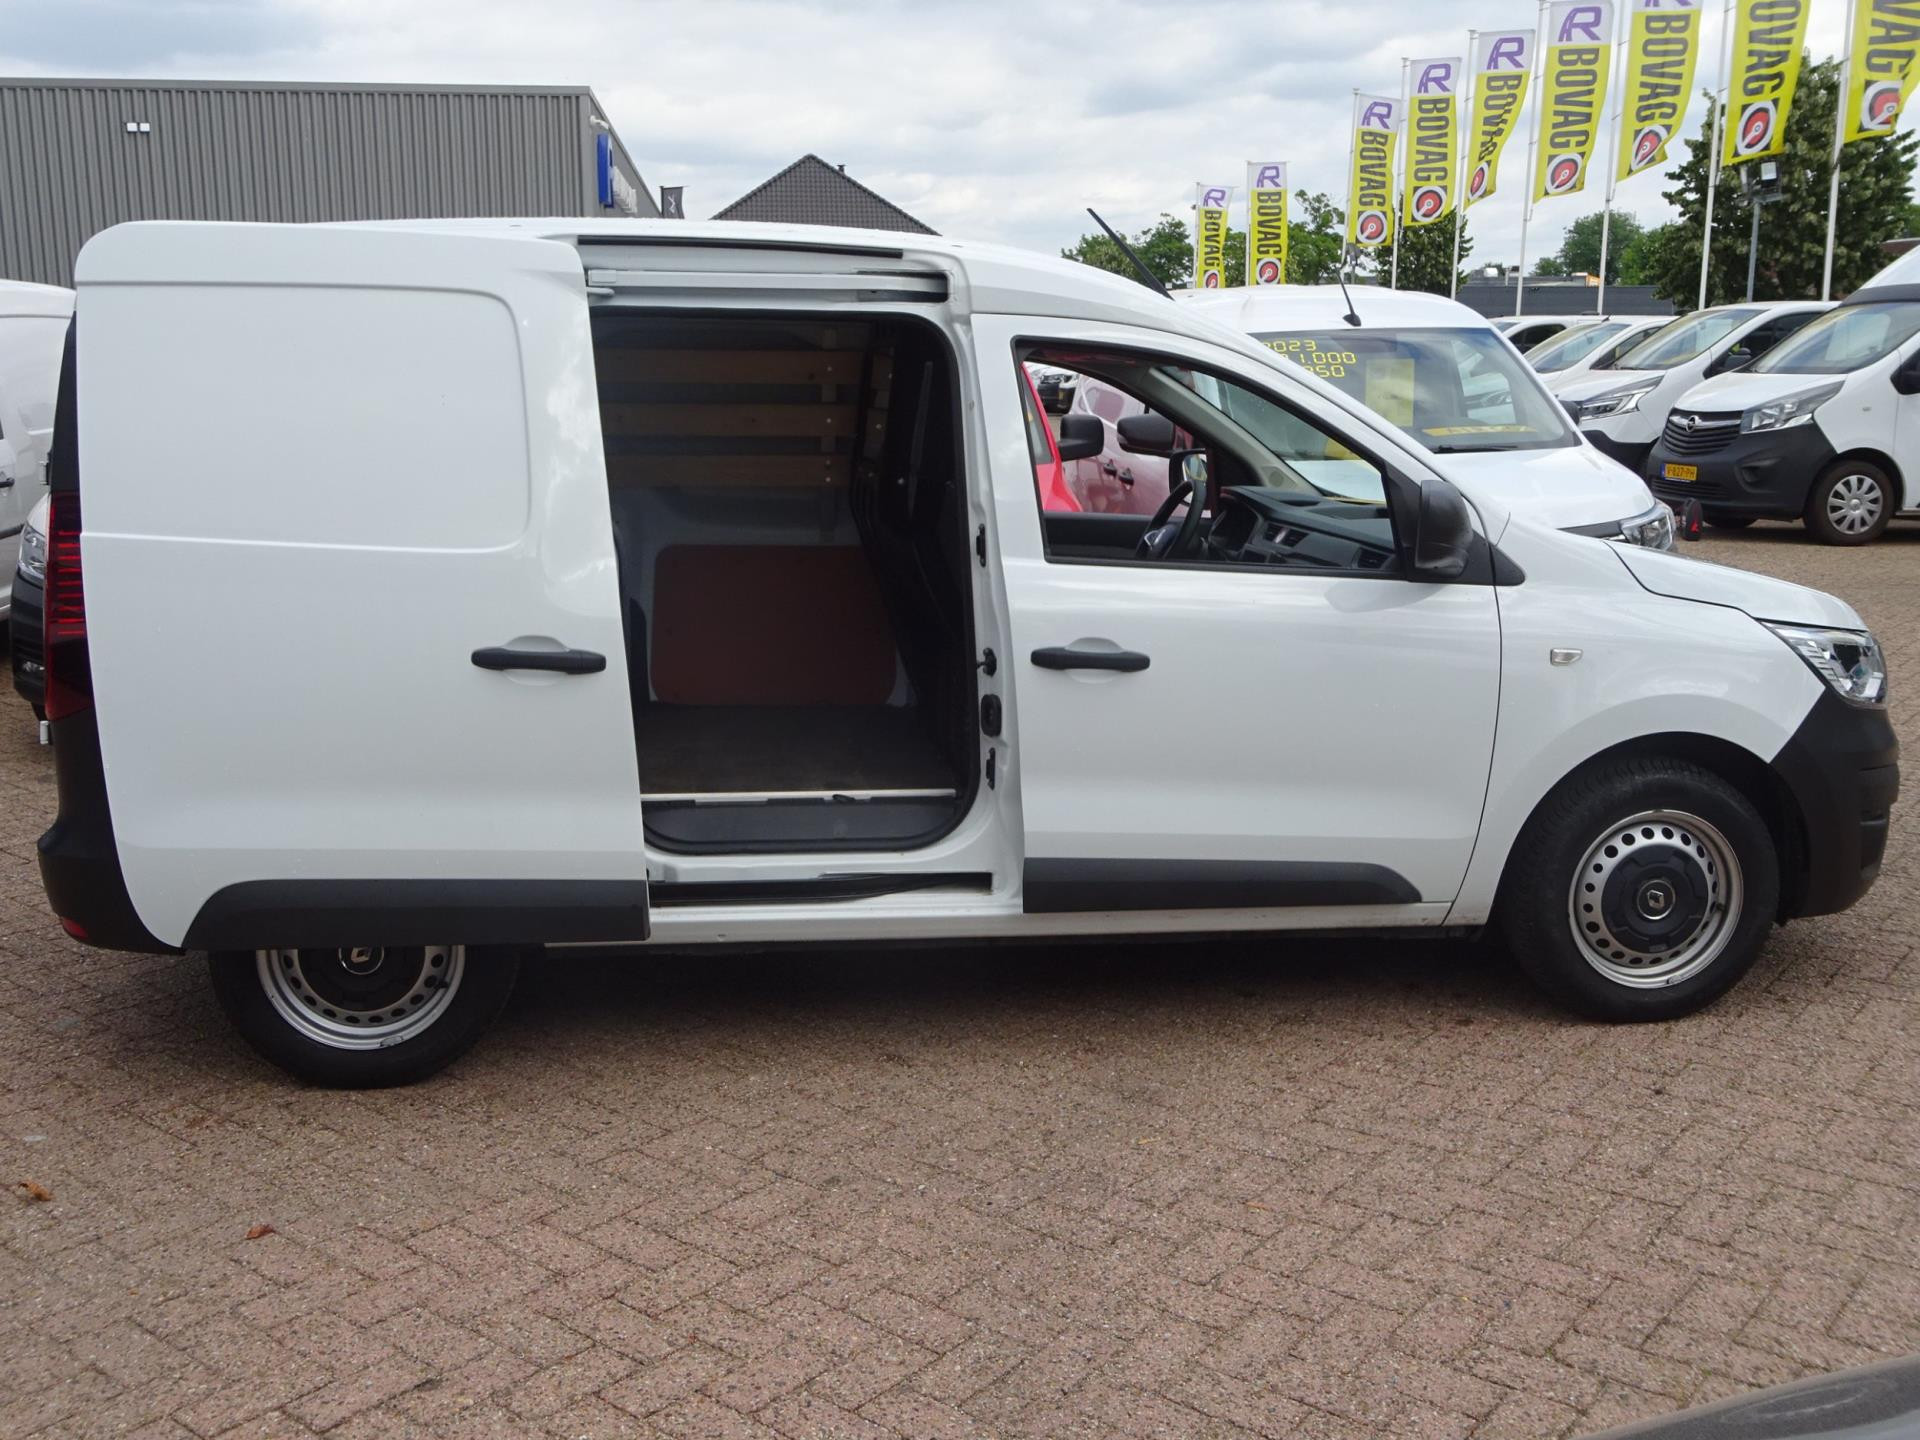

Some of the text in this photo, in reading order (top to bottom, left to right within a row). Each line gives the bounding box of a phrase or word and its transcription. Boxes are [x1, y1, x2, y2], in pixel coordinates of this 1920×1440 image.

[1635, 14, 1691, 123] BOVAG
[1743, 0, 1800, 97] OVAG
[1865, 0, 1920, 73] VAG
[1549, 48, 1600, 149] BOVAG
[1358, 131, 1389, 207] BOVAG
[1414, 98, 1450, 182] BOVAG
[1204, 210, 1222, 267] BOVAG
[1257, 191, 1282, 255] BOVAG
[1280, 352, 1356, 364] 1.000
